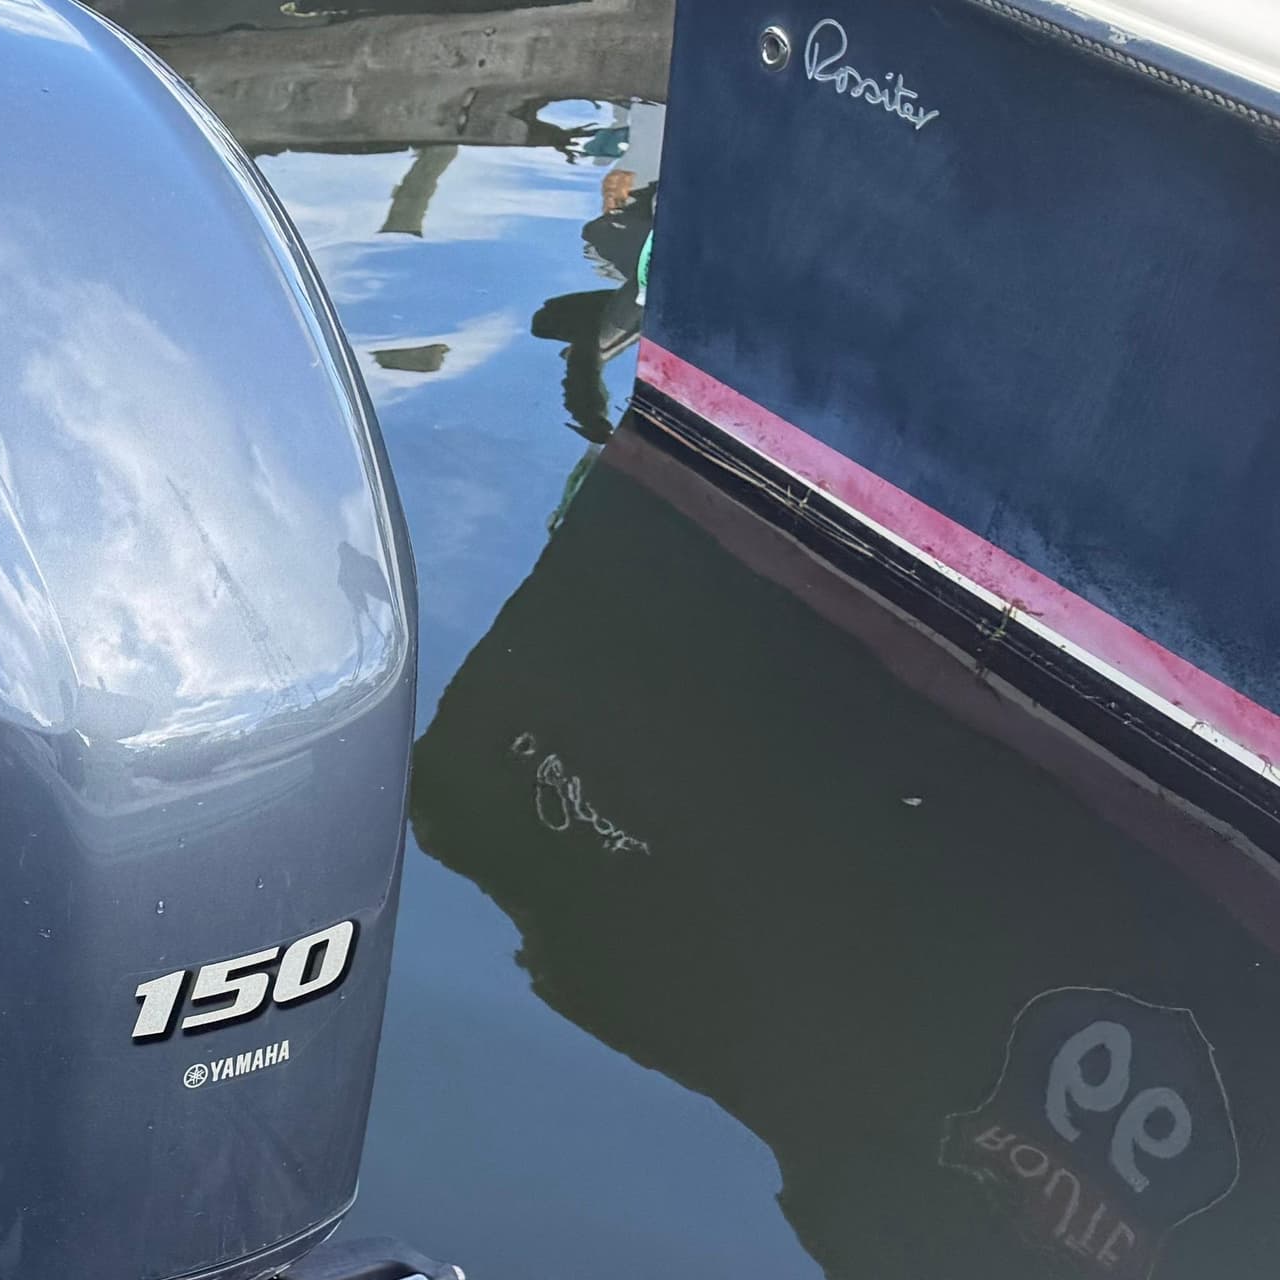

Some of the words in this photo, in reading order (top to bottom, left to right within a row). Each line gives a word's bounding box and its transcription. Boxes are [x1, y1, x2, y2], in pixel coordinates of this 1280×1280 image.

[804, 18, 939, 130] Rossiter
[132, 919, 355, 1039] 150
[210, 1039, 290, 1082] YAMAHA
